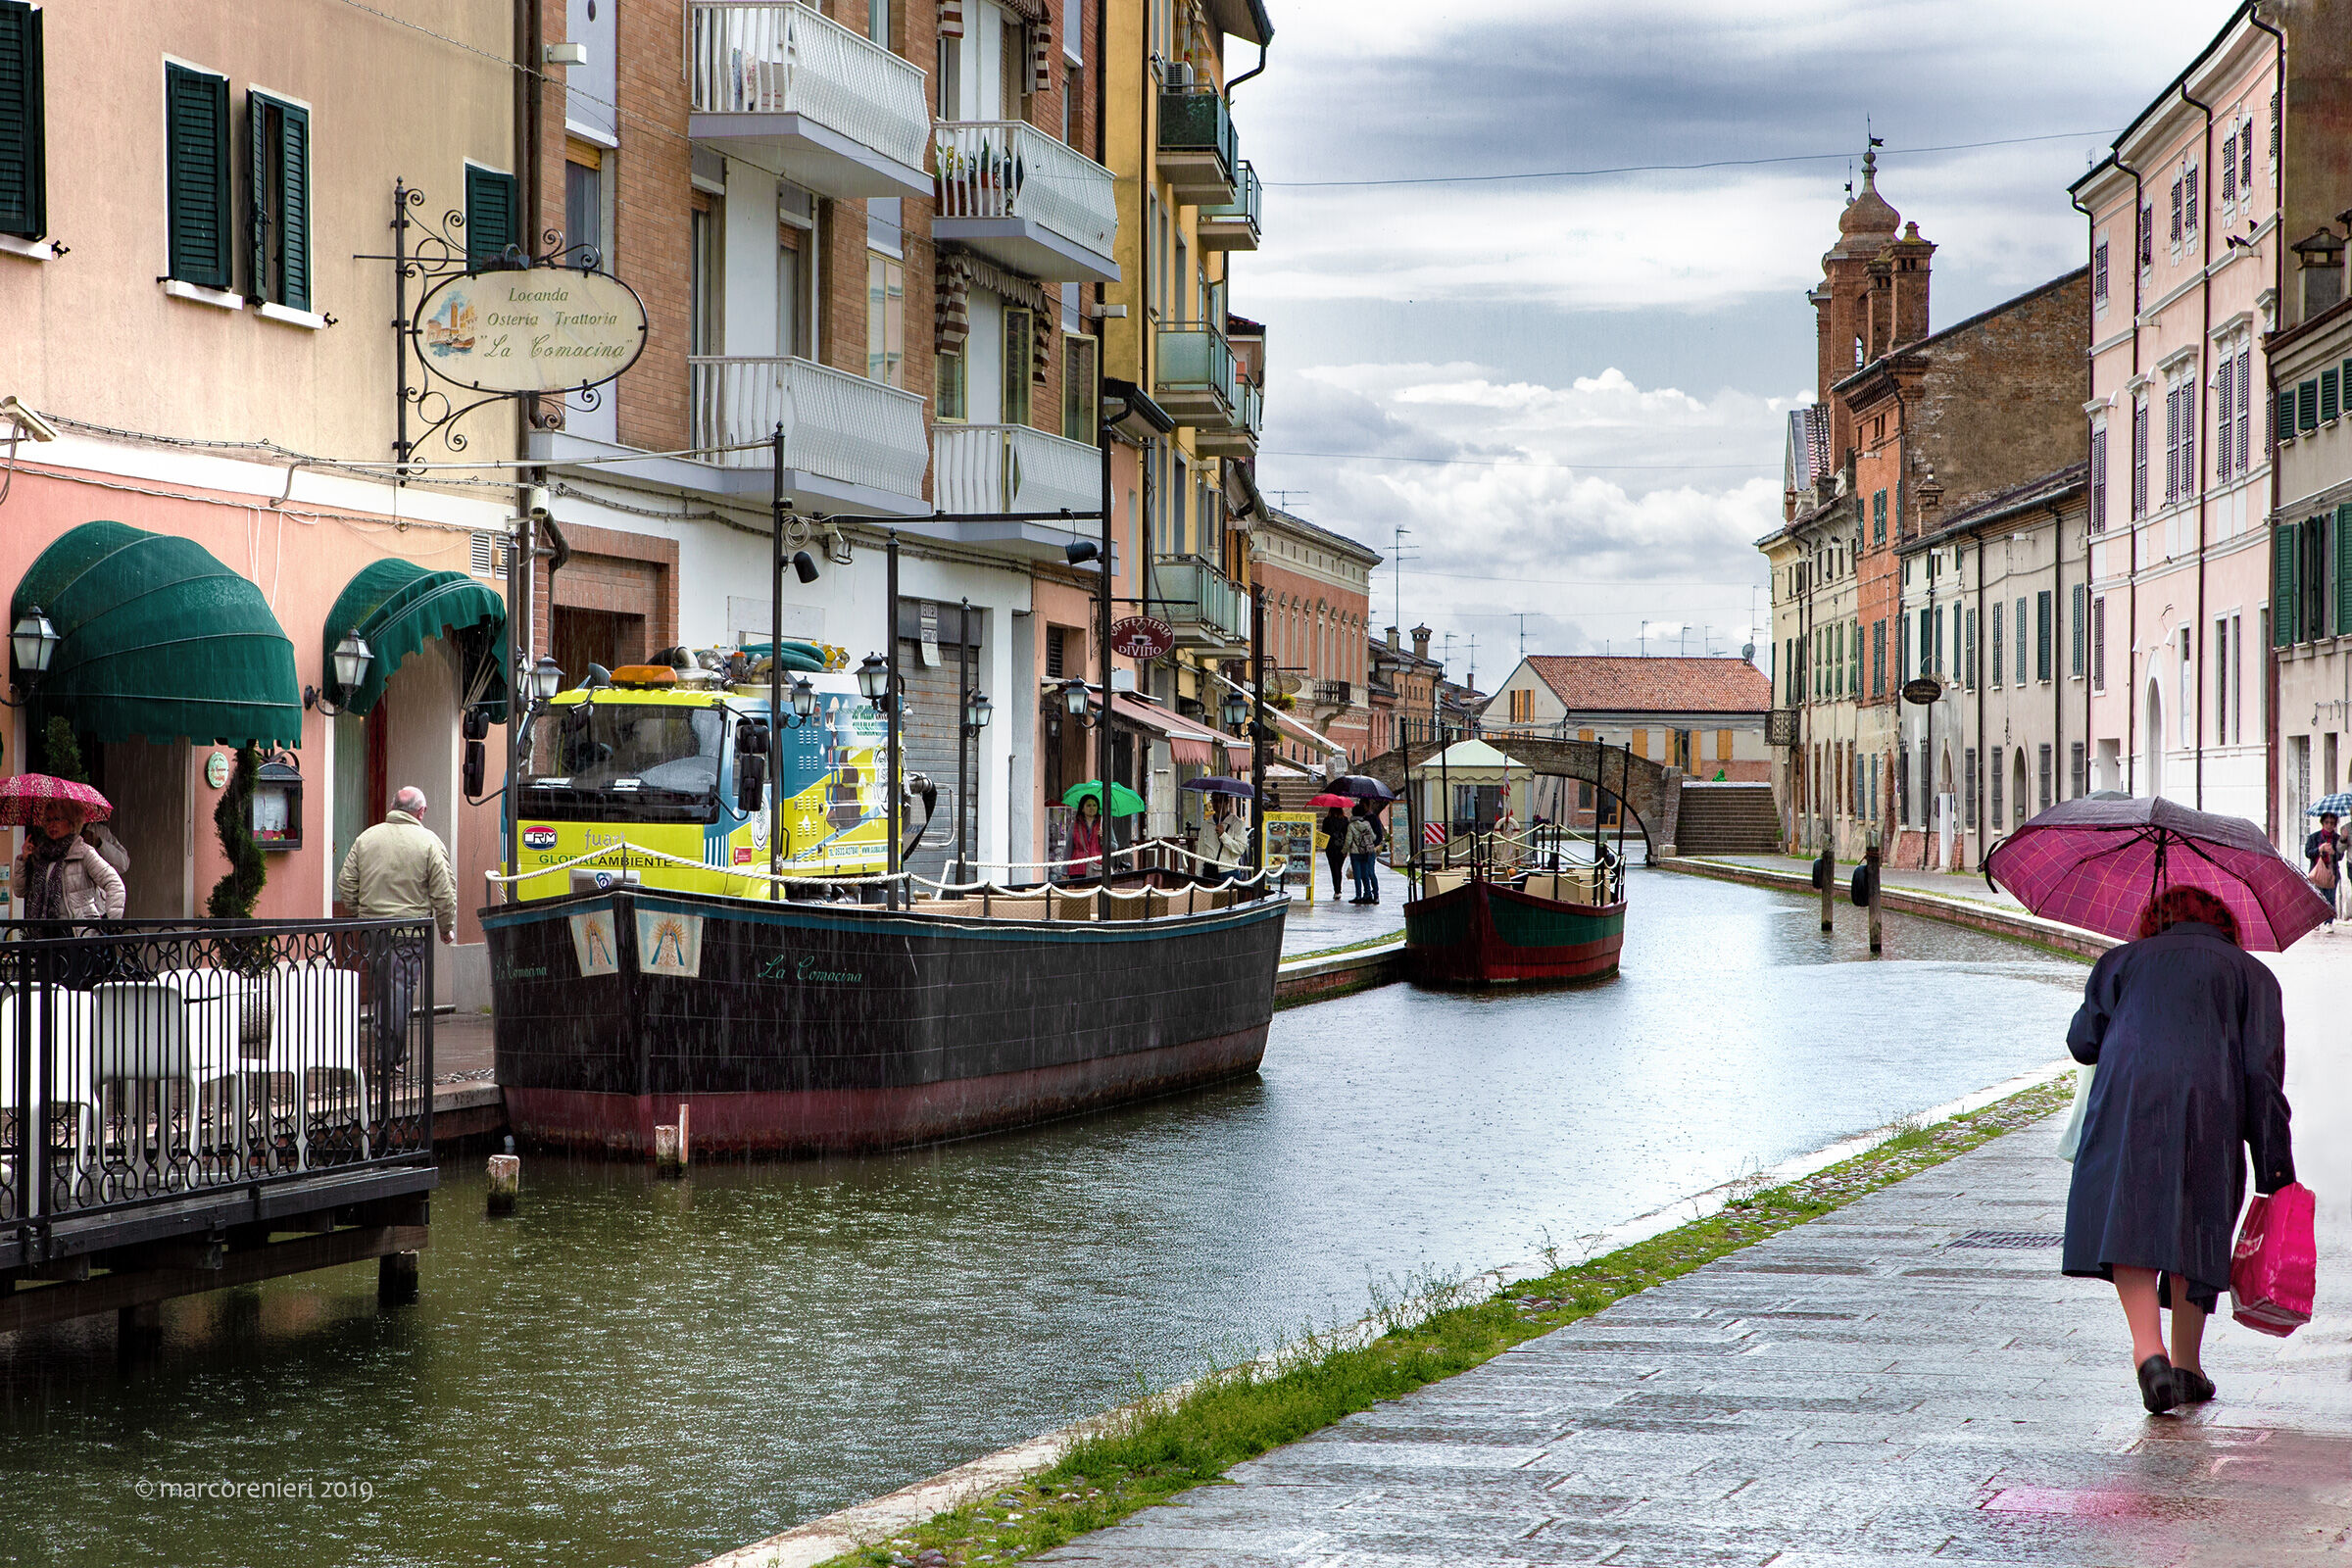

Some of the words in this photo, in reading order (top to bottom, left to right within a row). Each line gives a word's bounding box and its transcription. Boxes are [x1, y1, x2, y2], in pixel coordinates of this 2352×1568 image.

[509, 287, 568, 302] Locanda
[487, 313, 539, 326] Osteria
[555, 312, 618, 325] Trattoria
[1118, 645, 1162, 657] DIVINO
[523, 832, 557, 844] CRM
[758, 955, 786, 979] La
[797, 956, 862, 982] Comacina
